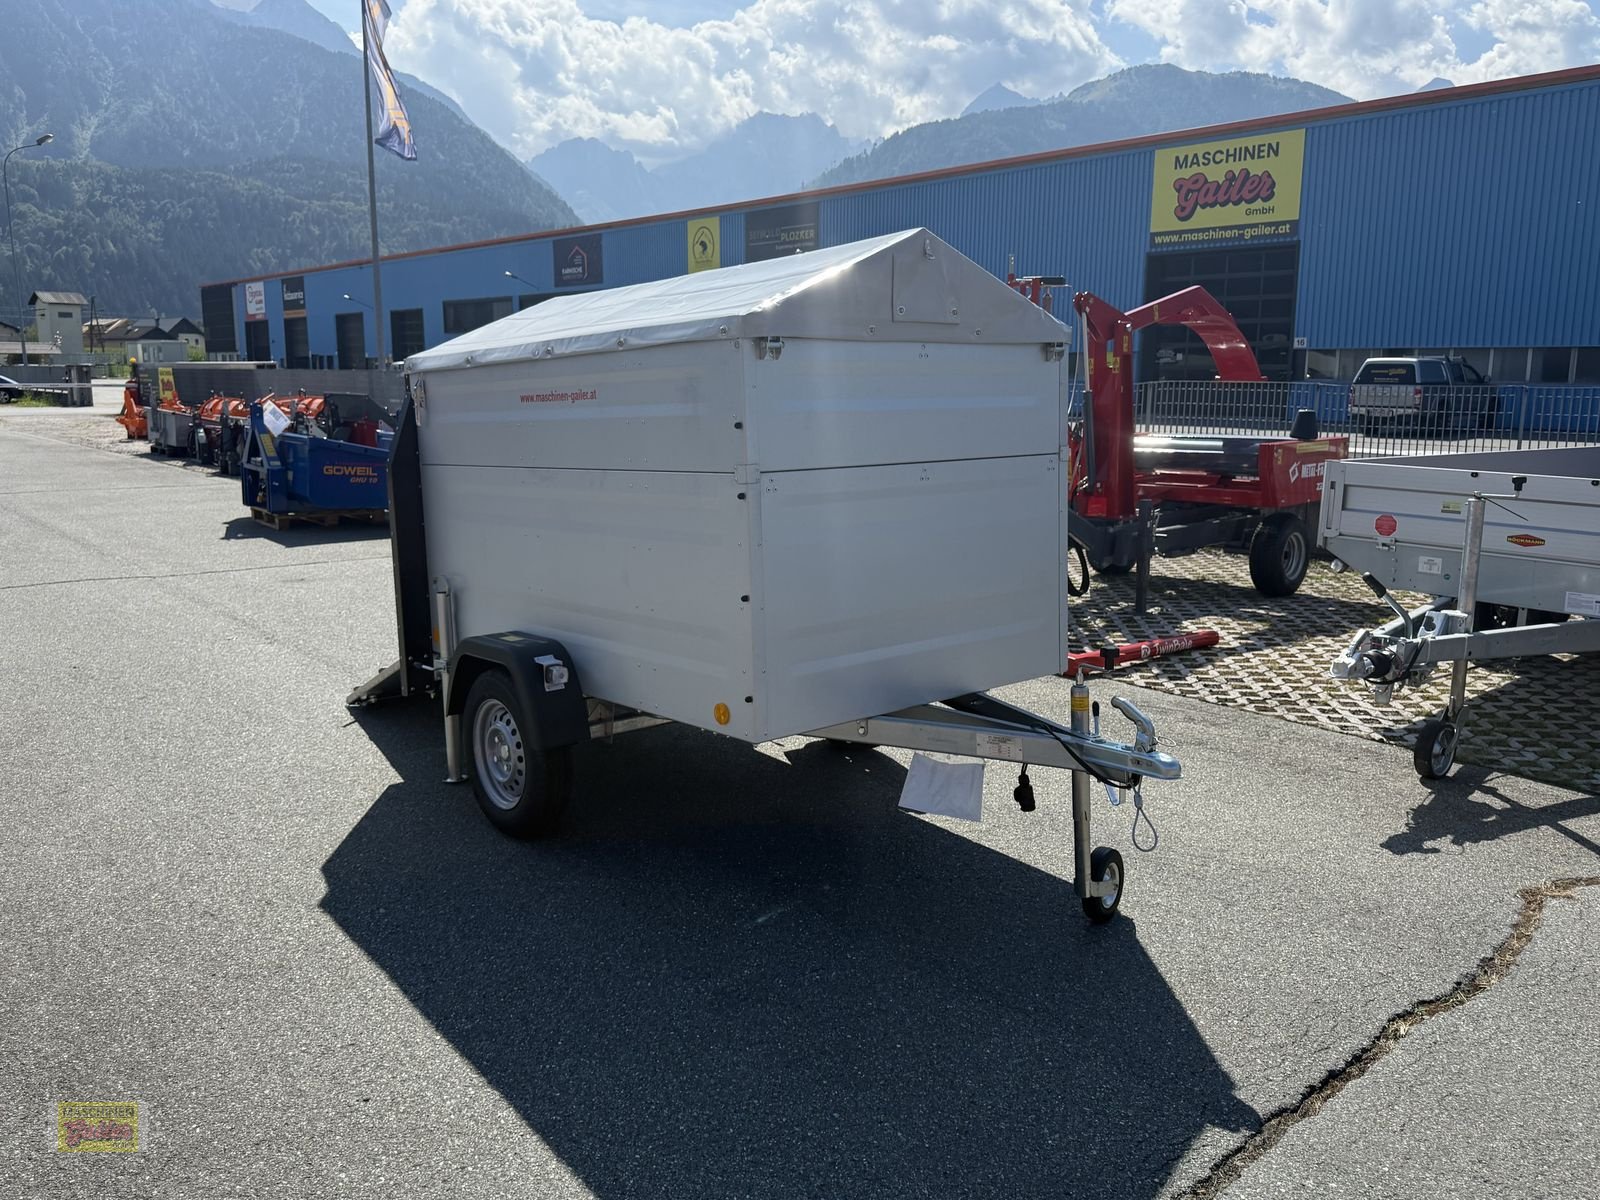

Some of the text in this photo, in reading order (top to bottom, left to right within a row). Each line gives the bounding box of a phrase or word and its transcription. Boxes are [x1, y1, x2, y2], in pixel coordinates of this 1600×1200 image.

[1174, 141, 1280, 170] MASCHINEN
[1173, 168, 1276, 222] Gailer
[1245, 206, 1275, 216] GmbH
[1154, 223, 1291, 244] www.maschinen-gailer.at
[519, 389, 597, 403] www.maschinen-gailer.at
[1153, 637, 1193, 655] TwinBale
